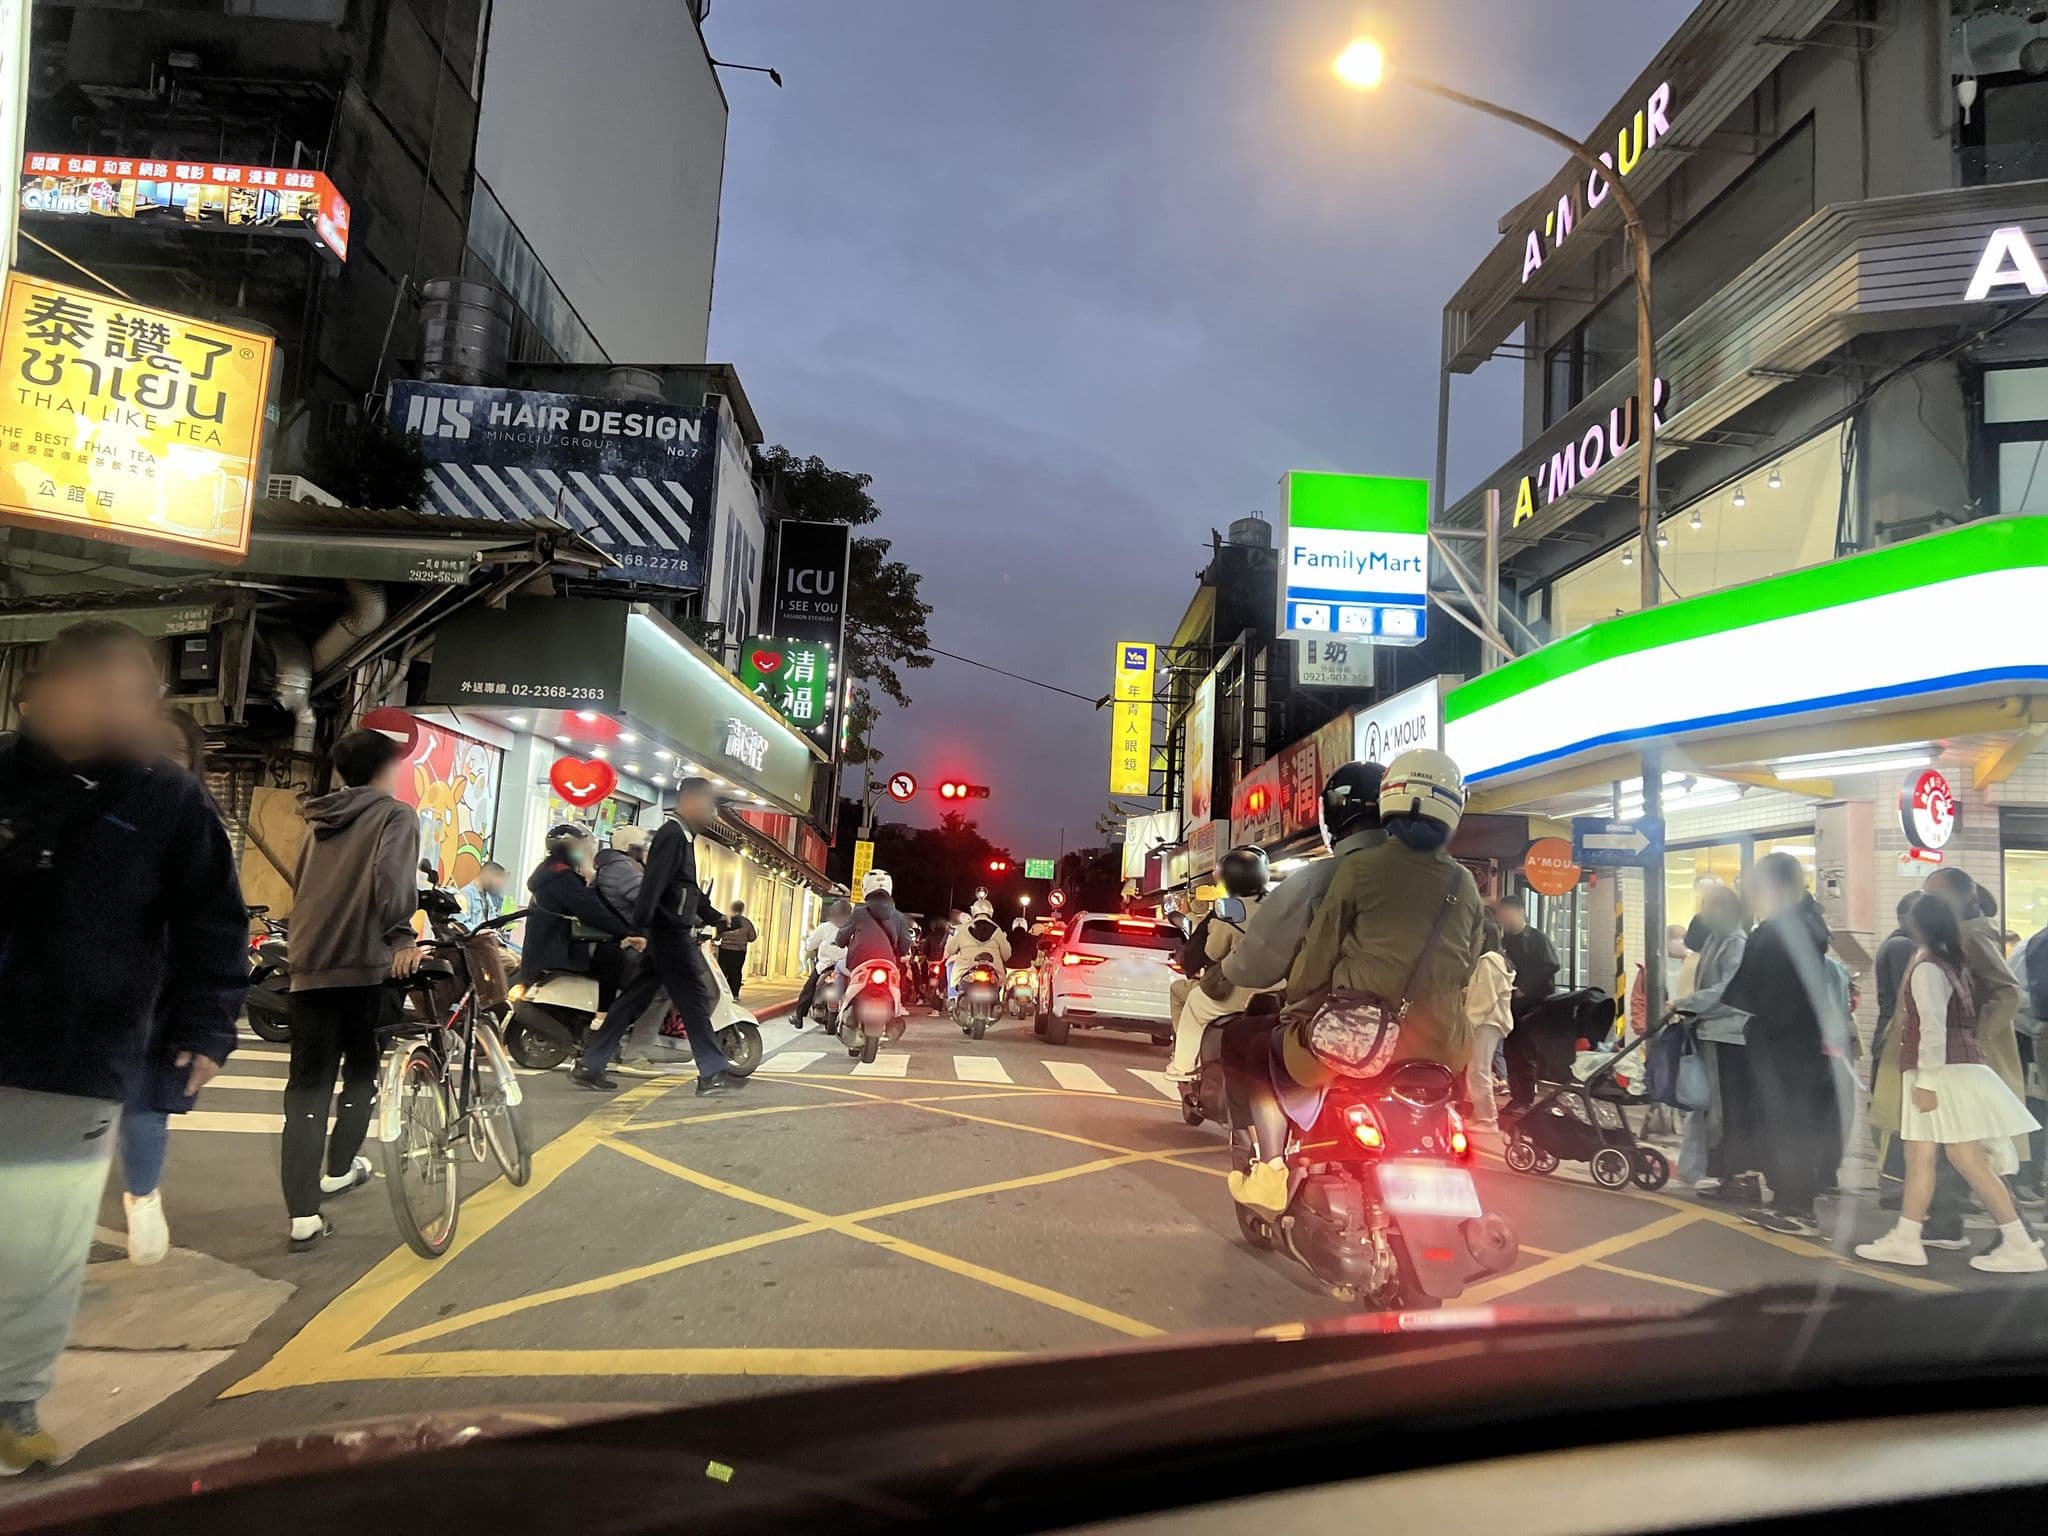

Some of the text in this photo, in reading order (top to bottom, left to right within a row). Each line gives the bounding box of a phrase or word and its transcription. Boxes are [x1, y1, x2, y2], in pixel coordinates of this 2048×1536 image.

[22, 188, 90, 213] Qtime
[24, 293, 233, 380] 泰讚了
[18, 388, 222, 445] THAI LIKE TEA
[489, 402, 570, 431] HAIR
[579, 411, 701, 443] DESIGN
[35, 431, 70, 447] BEST
[84, 440, 117, 457] THAI
[131, 450, 156, 464] TEA
[487, 431, 614, 449] MINGLIU GROUP
[38, 480, 115, 508] 公館店
[607, 552, 689, 571] 368.2278
[1293, 546, 1422, 575] FamilyMart
[787, 568, 835, 595] ICU
[780, 599, 839, 614] I SEE YOU
[512, 684, 605, 700] 02-2368-2363
[1124, 685, 1141, 771] 年青人眼鏡
[1383, 714, 1426, 752] A'MOUR
[1527, 856, 1580, 869] A'MOU
